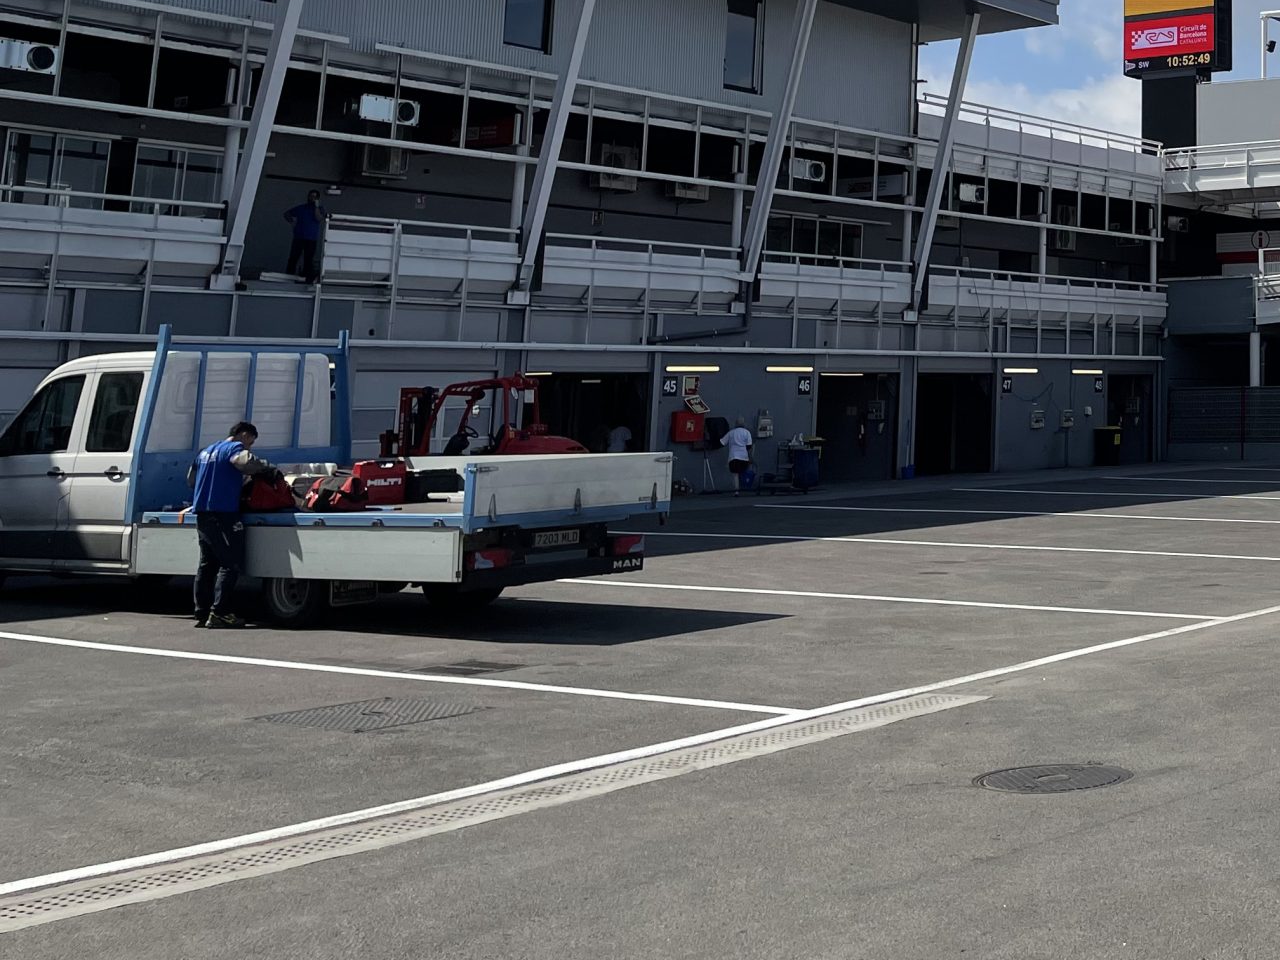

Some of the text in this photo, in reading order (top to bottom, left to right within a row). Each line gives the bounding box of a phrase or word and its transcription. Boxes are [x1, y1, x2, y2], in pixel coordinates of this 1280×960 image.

[1180, 31, 1207, 39] Barcelona
[1180, 37, 1207, 45] CATALUNYA
[1138, 53, 1211, 69] SW 10:52:49
[663, 380, 677, 393] 45
[799, 380, 810, 392] 46
[1002, 379, 1012, 391] 47
[366, 477, 402, 487] HILTI
[613, 557, 641, 569] MAN
